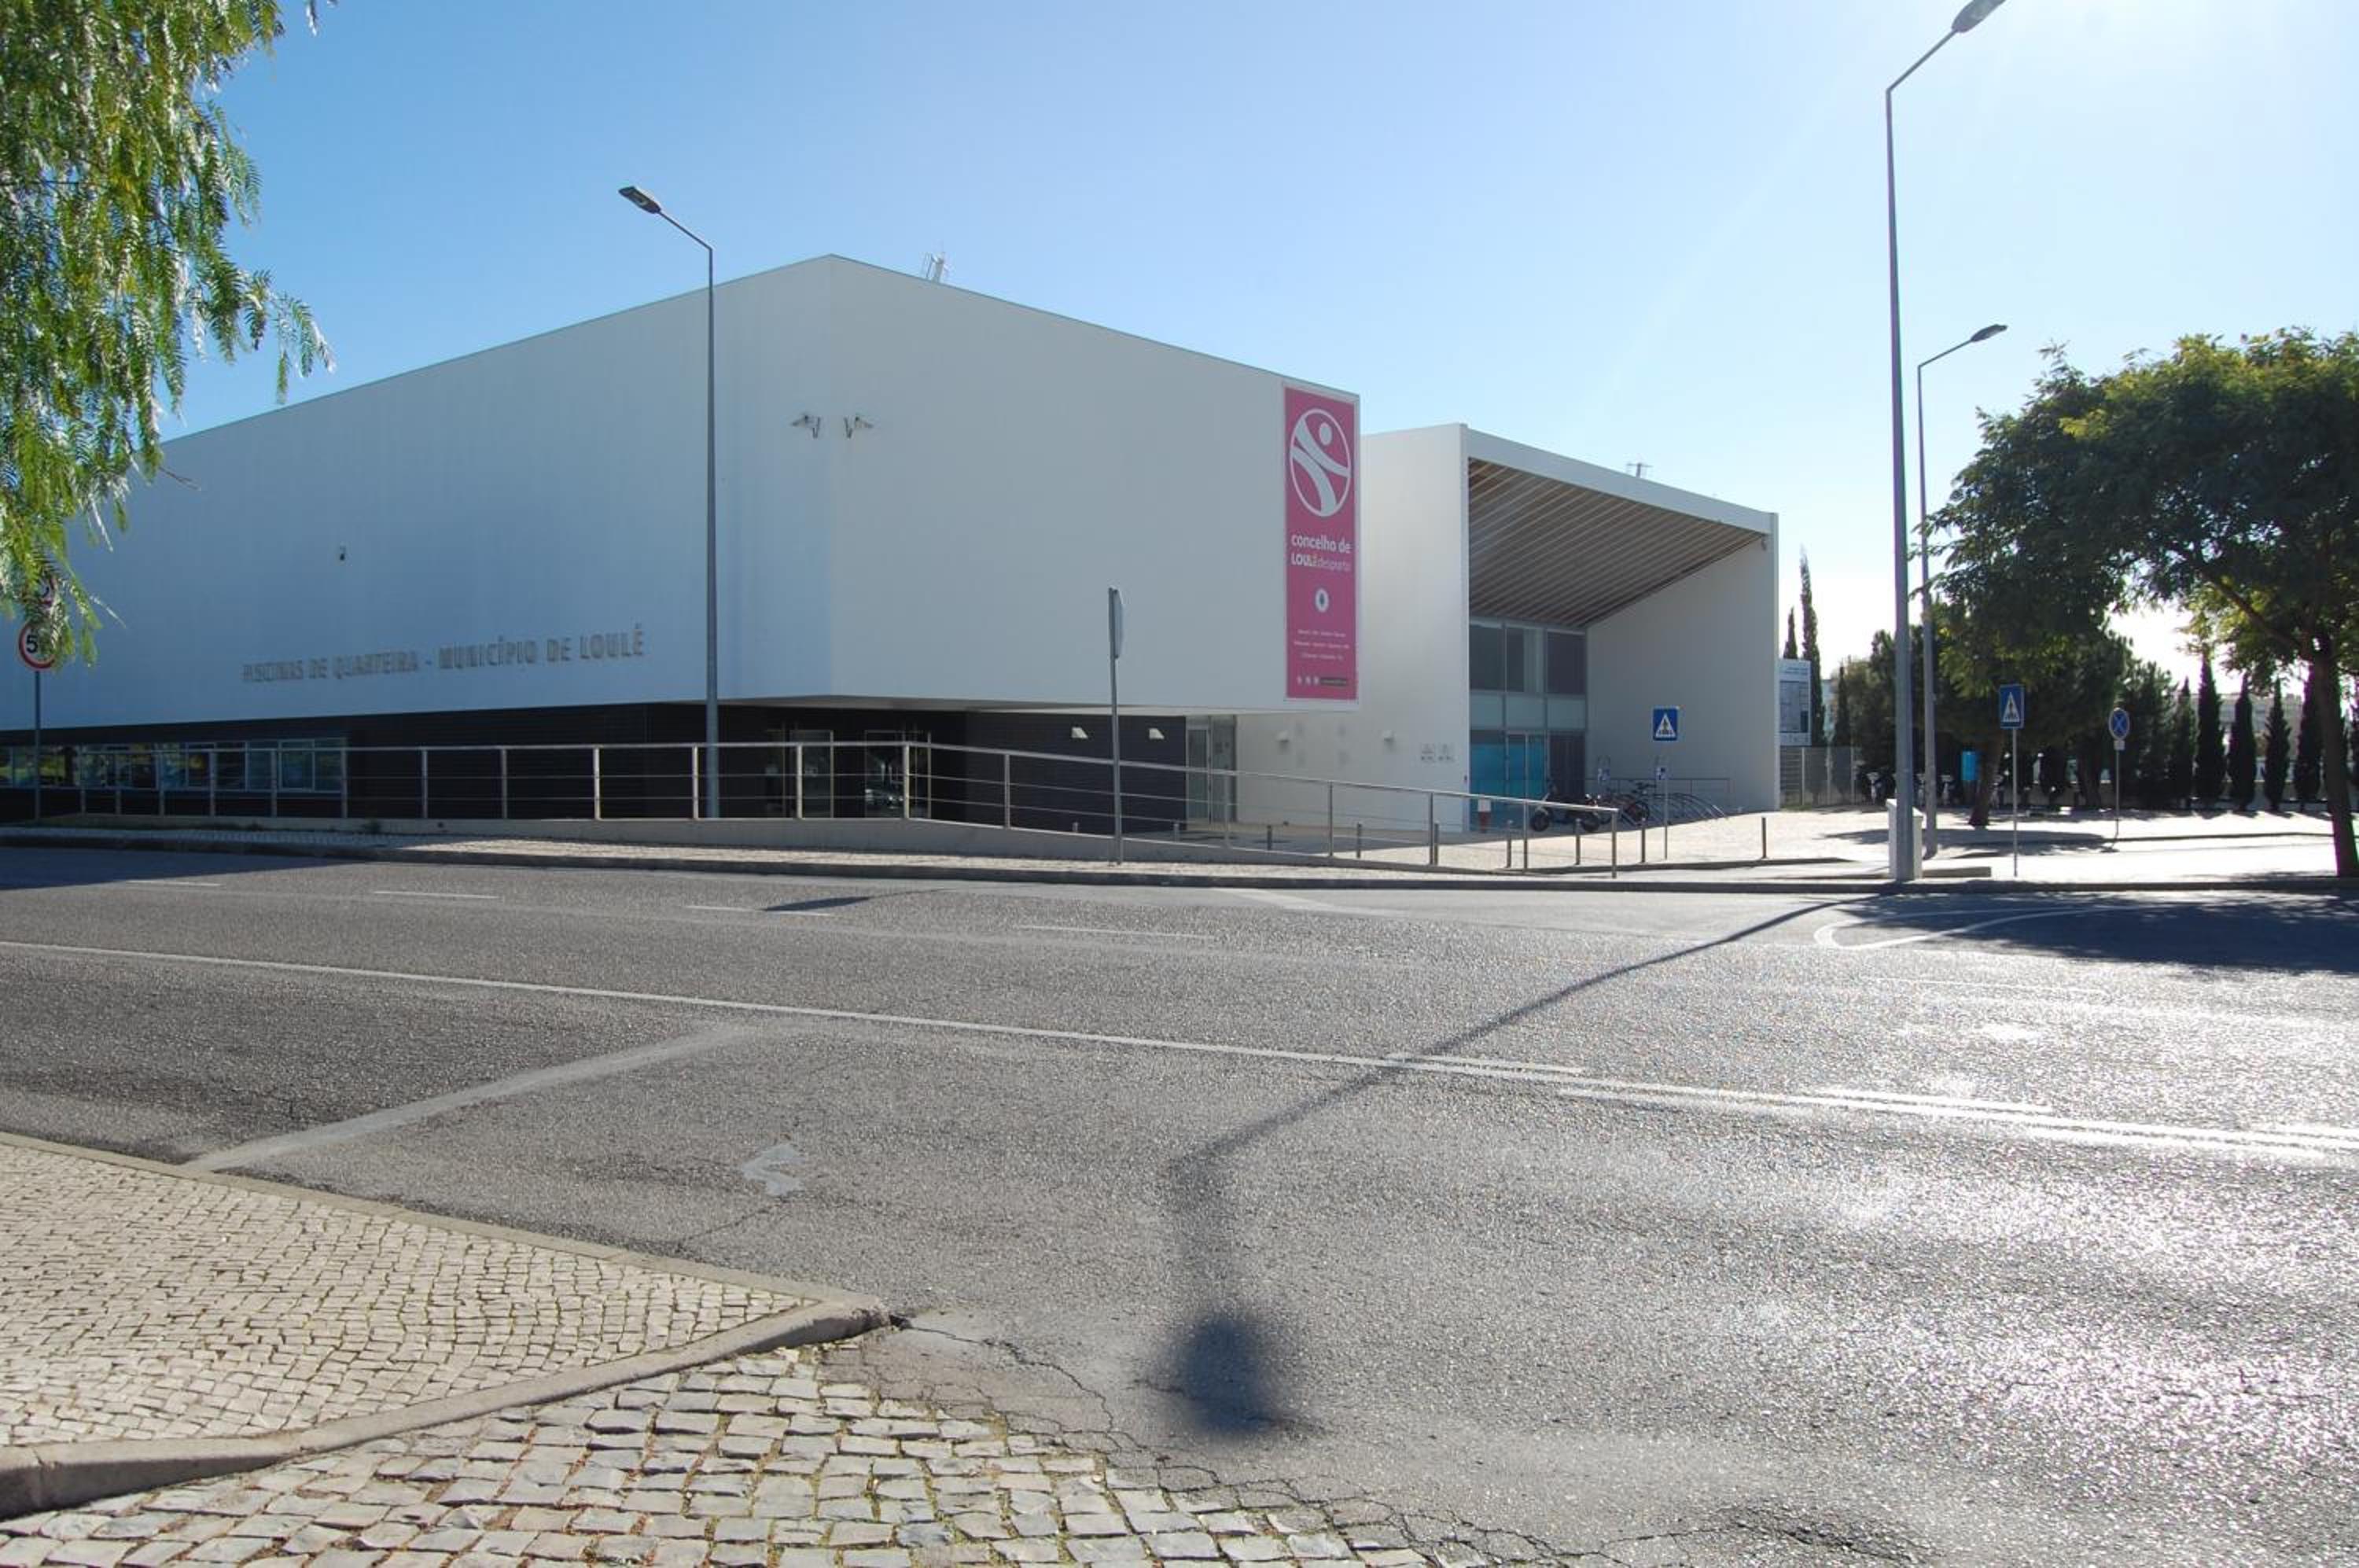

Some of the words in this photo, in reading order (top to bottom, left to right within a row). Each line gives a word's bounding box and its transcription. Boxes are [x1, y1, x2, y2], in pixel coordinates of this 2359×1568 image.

[1291, 534, 1336, 552] concelho
[1338, 536, 1351, 554] de
[439, 635, 537, 669] MUNICÍPIO
[547, 636, 572, 662] DE
[580, 623, 644, 660] LOULÉ
